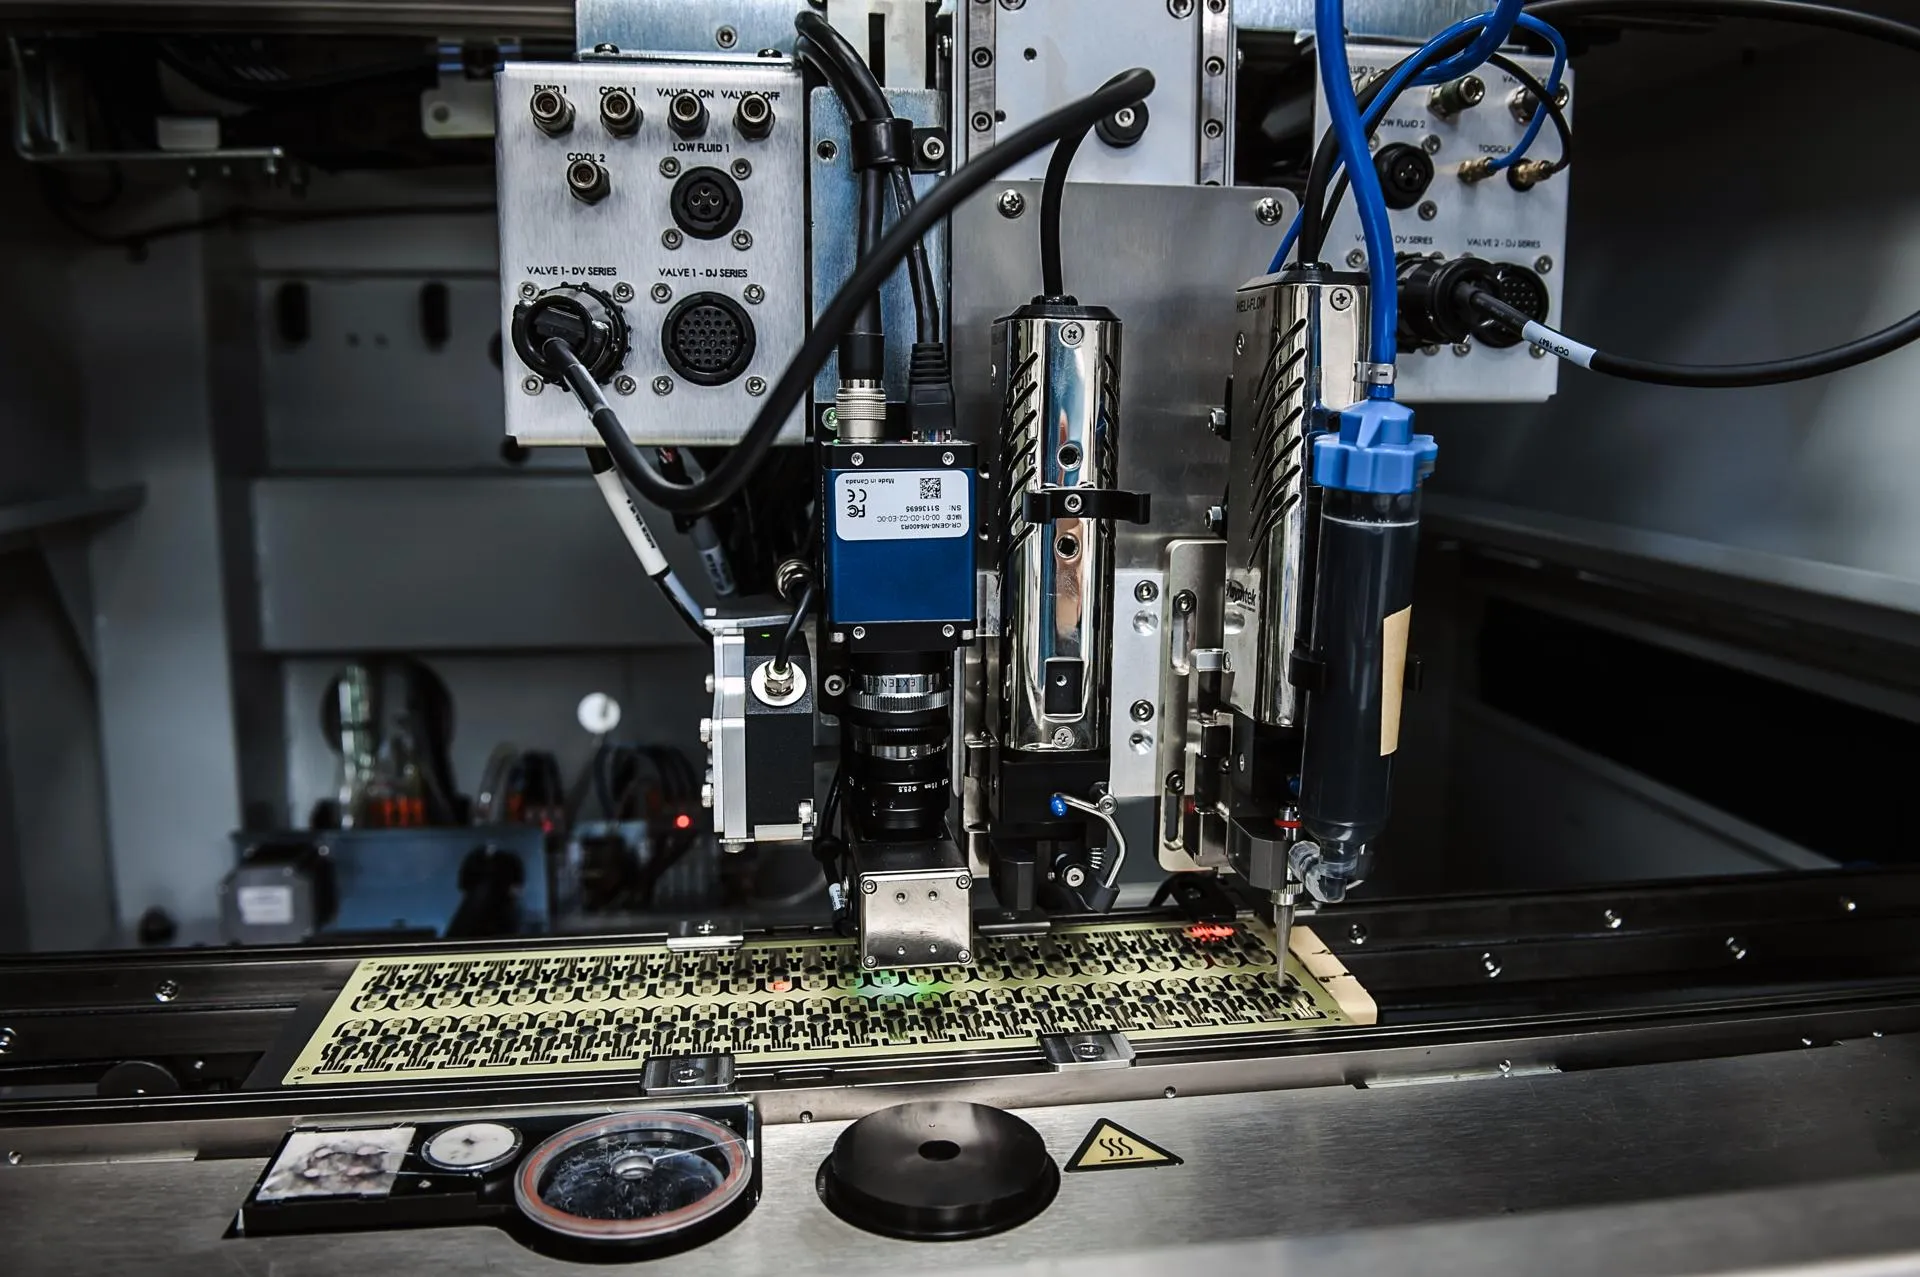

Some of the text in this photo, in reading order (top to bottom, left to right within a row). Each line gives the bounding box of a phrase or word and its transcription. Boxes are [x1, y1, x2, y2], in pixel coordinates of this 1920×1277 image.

[563, 85, 567, 94] 1
[632, 87, 636, 96] 1
[698, 89, 714, 98] ON
[763, 91, 780, 100] OFF
[1381, 119, 1395, 127] OW
[673, 143, 730, 153] LOW FLUID 1
[567, 153, 606, 163] COOL 2
[1467, 238, 1492, 247] VALVE
[526, 266, 558, 275] VALVE
[571, 266, 586, 275] DV
[587, 266, 617, 276] SERIES
[658, 268, 690, 277] VALVE
[692, 268, 696, 277] 1
[705, 268, 717, 277] DJ
[719, 268, 748, 278] SERIES
